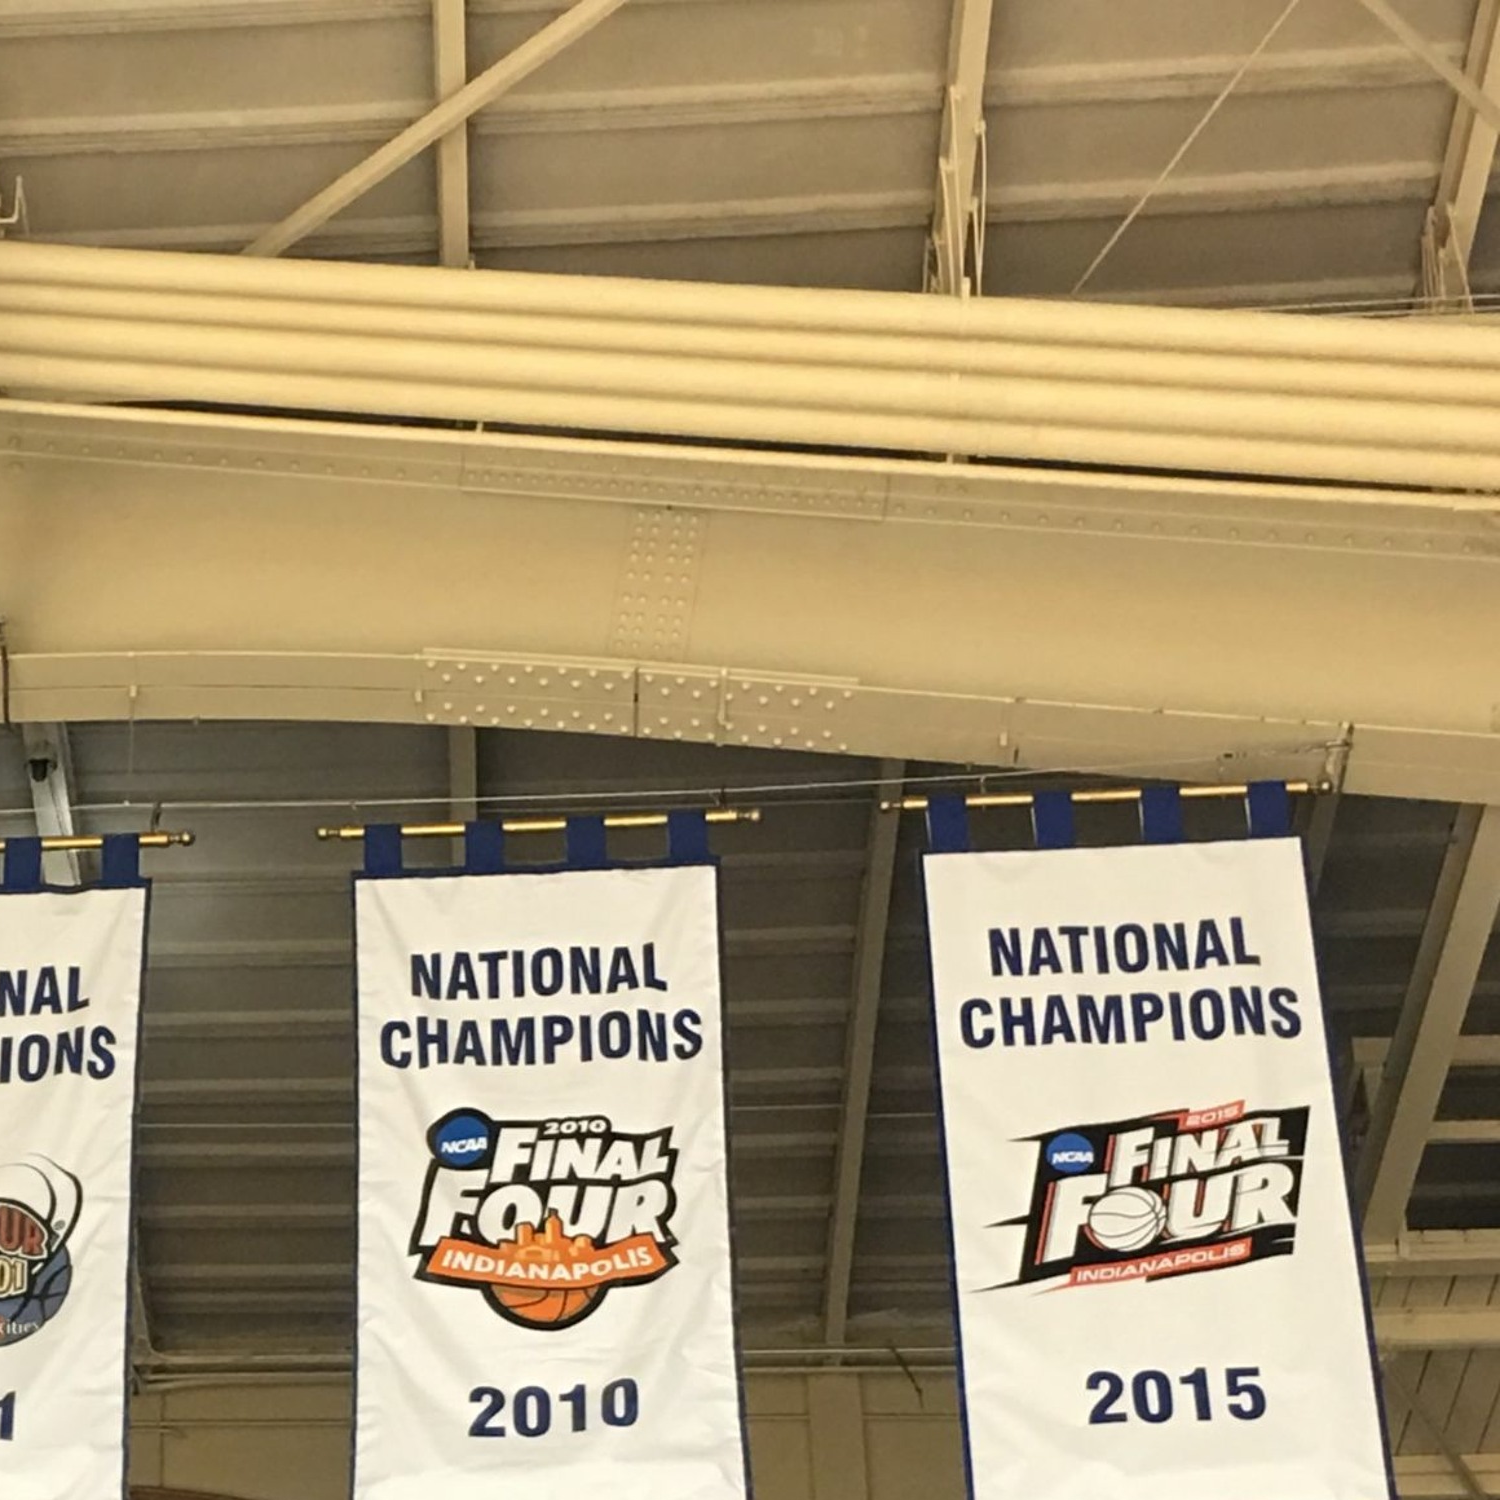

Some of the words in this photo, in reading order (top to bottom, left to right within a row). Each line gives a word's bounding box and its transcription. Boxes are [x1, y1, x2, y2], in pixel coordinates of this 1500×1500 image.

[412, 943, 667, 999] NATIONAL
[989, 918, 1260, 976] NATIONAL
[381, 1010, 702, 1068] CHAMPIONS
[961, 987, 1301, 1048] CHAMPIONS
[543, 1119, 607, 1135] 2010
[1186, 1104, 1243, 1126] 2015
[441, 1137, 488, 1154] NCAA
[490, 1127, 671, 1182] FINAL
[1052, 1150, 1094, 1165] NCAA
[1109, 1117, 1290, 1187] FINAL
[418, 1167, 667, 1246] FOUR
[441, 1246, 654, 1281] INDIANAPOLIS
[1076, 1241, 1248, 1283] INDIANAPOLIS
[470, 1379, 637, 1437] 2010
[1087, 1368, 1265, 1424] 2015
